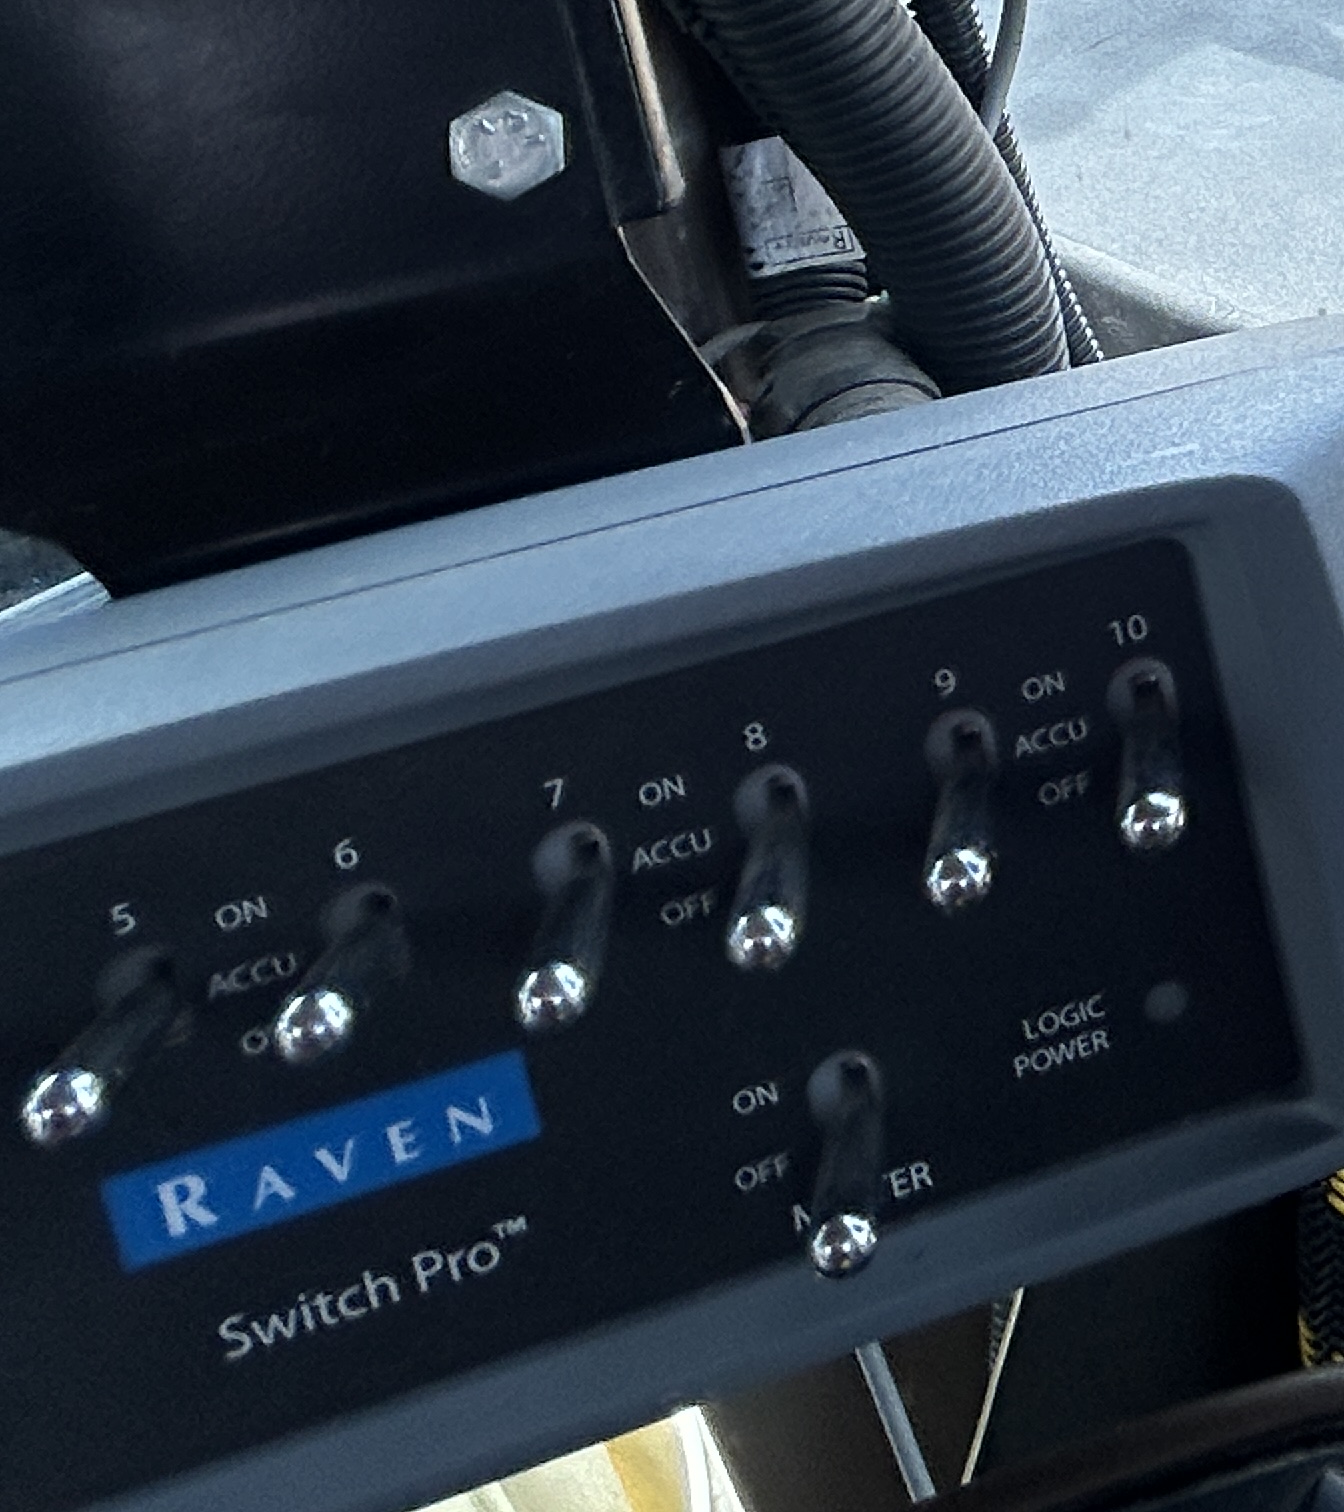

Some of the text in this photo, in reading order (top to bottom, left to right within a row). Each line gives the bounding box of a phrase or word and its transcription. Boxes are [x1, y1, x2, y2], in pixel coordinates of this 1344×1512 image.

[1110, 615, 1147, 645] 10
[935, 669, 956, 695] 9
[1022, 672, 1065, 701] ON
[744, 723, 767, 750] 8
[1016, 718, 1087, 757] ACCU
[544, 779, 563, 809] 7
[639, 775, 685, 805] ON
[1038, 770, 1090, 806] OFF
[335, 839, 358, 869] 6
[633, 829, 711, 871] ACCU
[111, 903, 135, 934] 5
[215, 896, 267, 928] ON
[660, 890, 716, 926] OFF
[209, 952, 298, 999] ACCU
[1023, 994, 1106, 1044] LOGIC
[1013, 1028, 1110, 1078] POWER
[733, 1083, 778, 1113] ON
[157, 1097, 496, 1238] RAVEN
[734, 1152, 789, 1191] OFF
[219, 1271, 400, 1359] Switch
